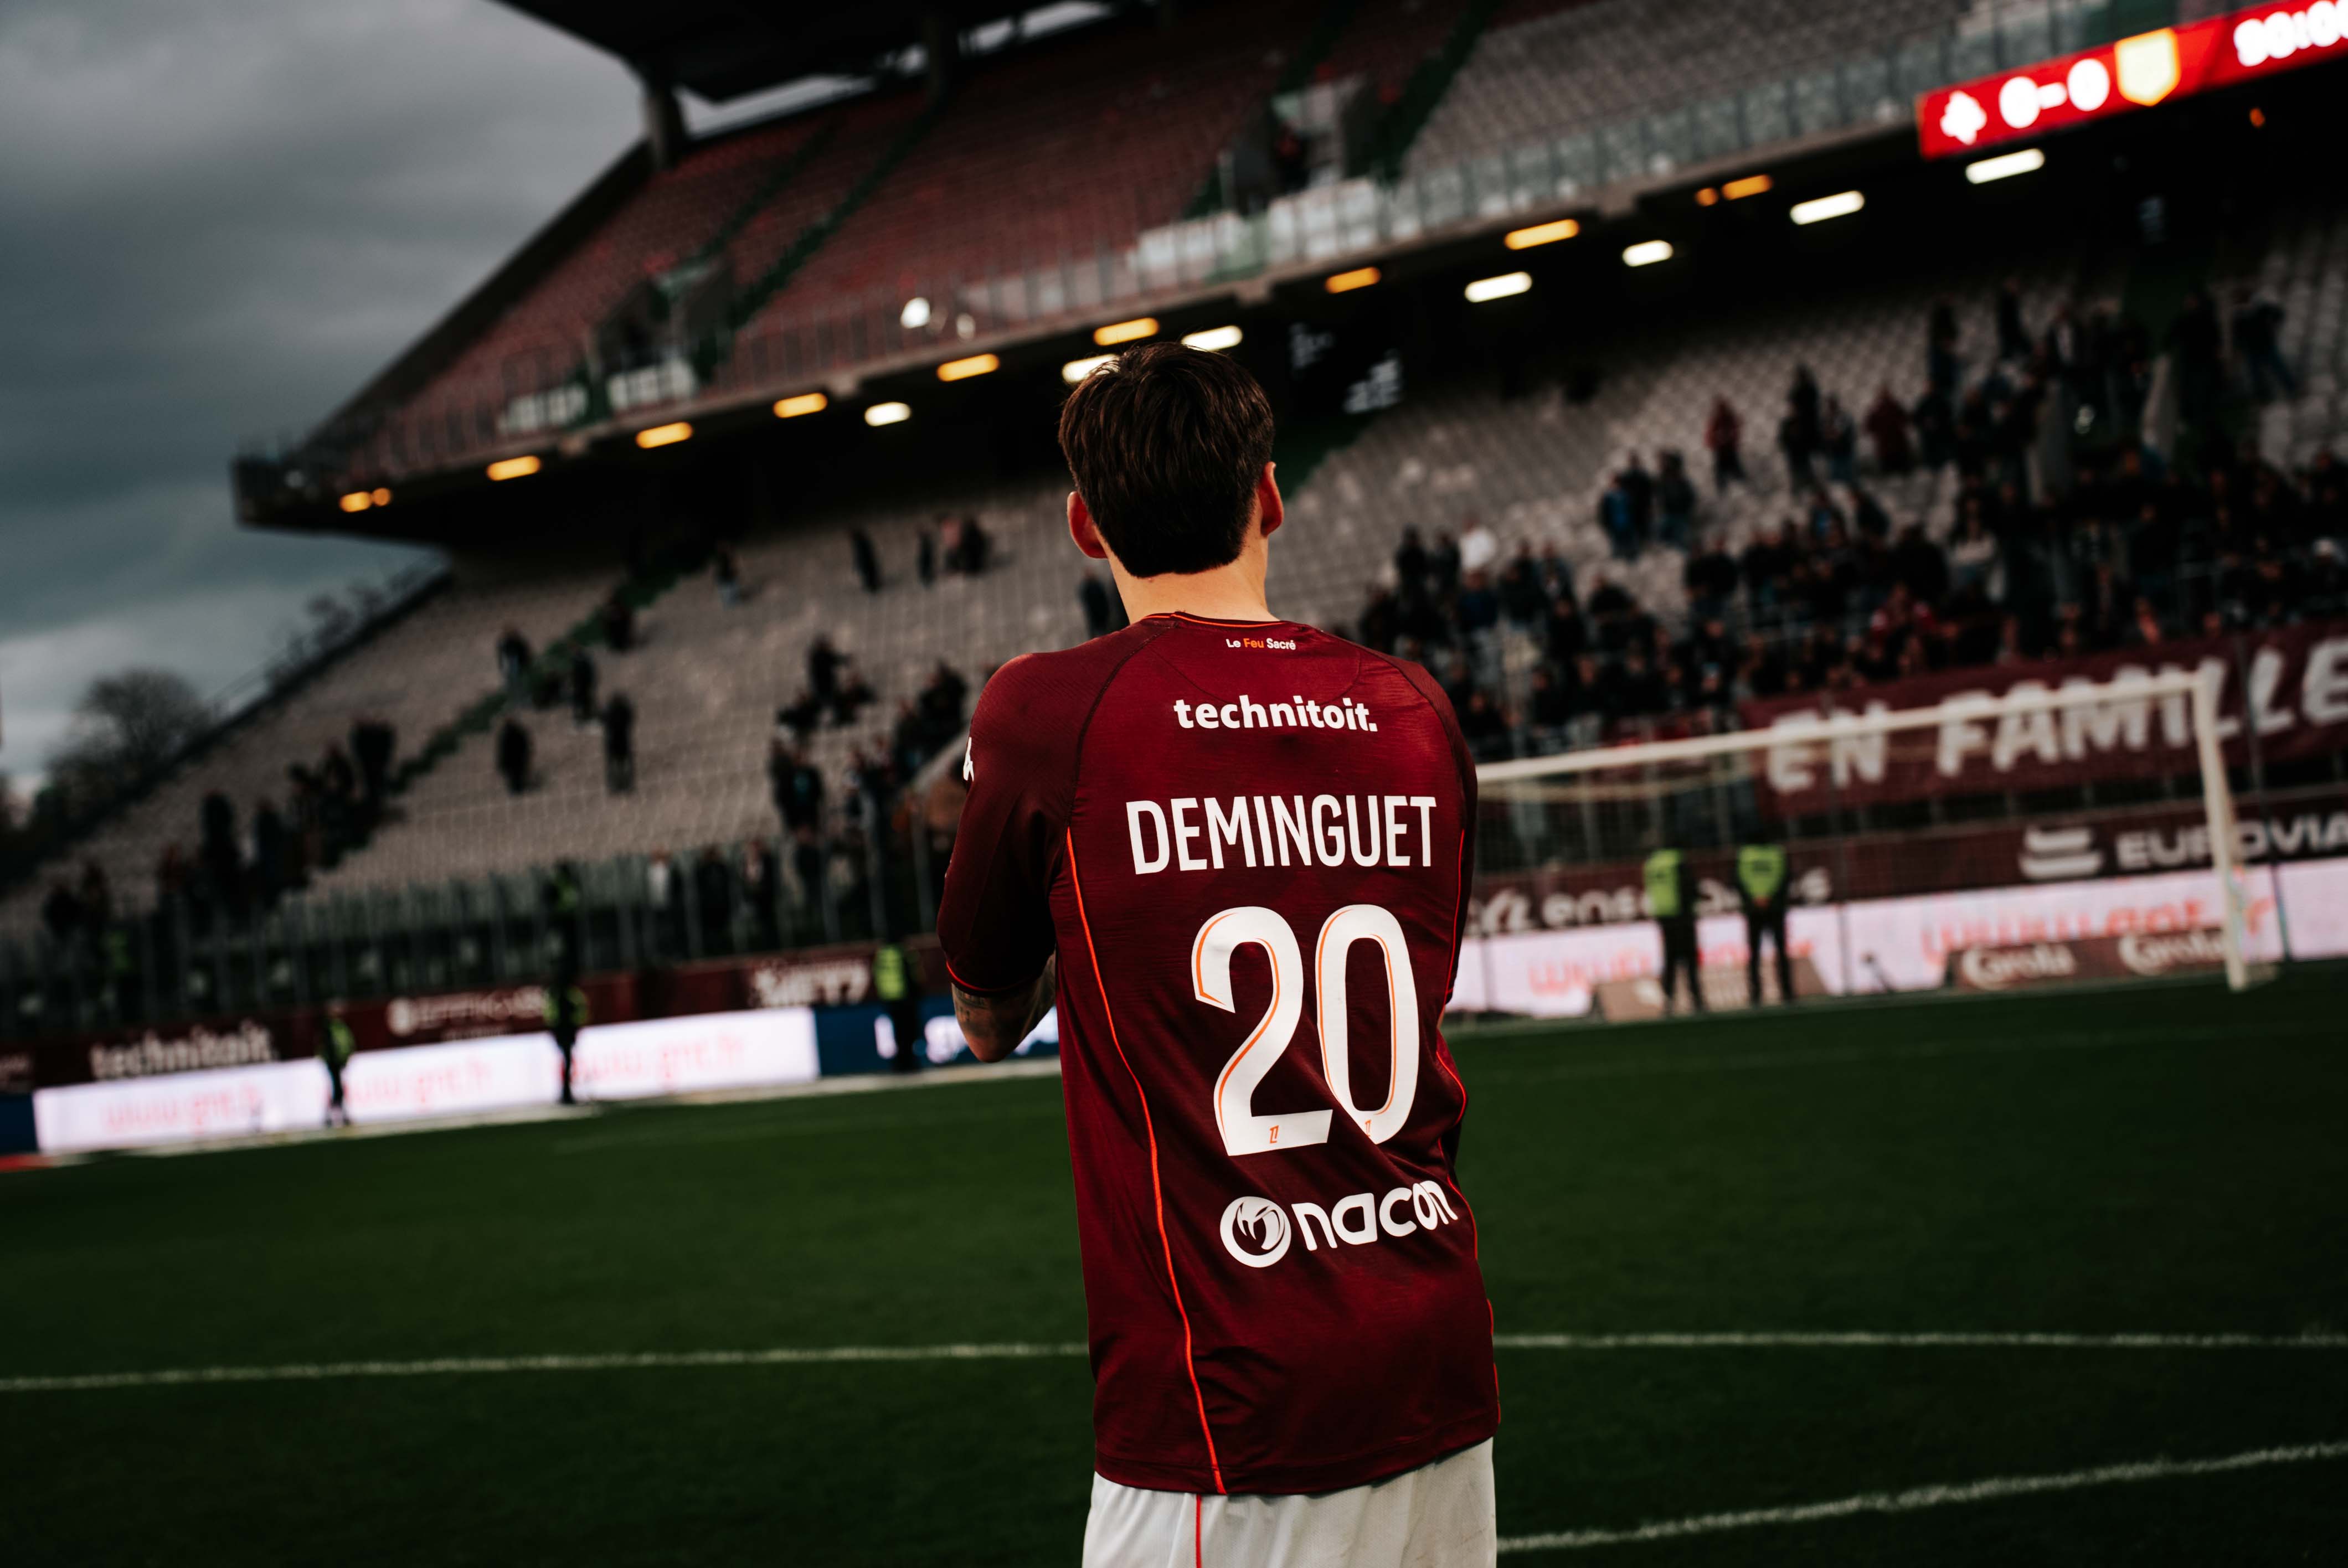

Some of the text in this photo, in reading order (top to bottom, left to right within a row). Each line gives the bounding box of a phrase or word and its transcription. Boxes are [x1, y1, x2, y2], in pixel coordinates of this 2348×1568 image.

[1226, 638, 1296, 651] Le Feu Sacré
[1173, 694, 1378, 732] technitoit.
[1764, 700, 1889, 793] EN
[1126, 794, 1436, 875] DEMINGUET
[1191, 904, 1420, 1157] 20
[1291, 1180, 1458, 1251] nacon
